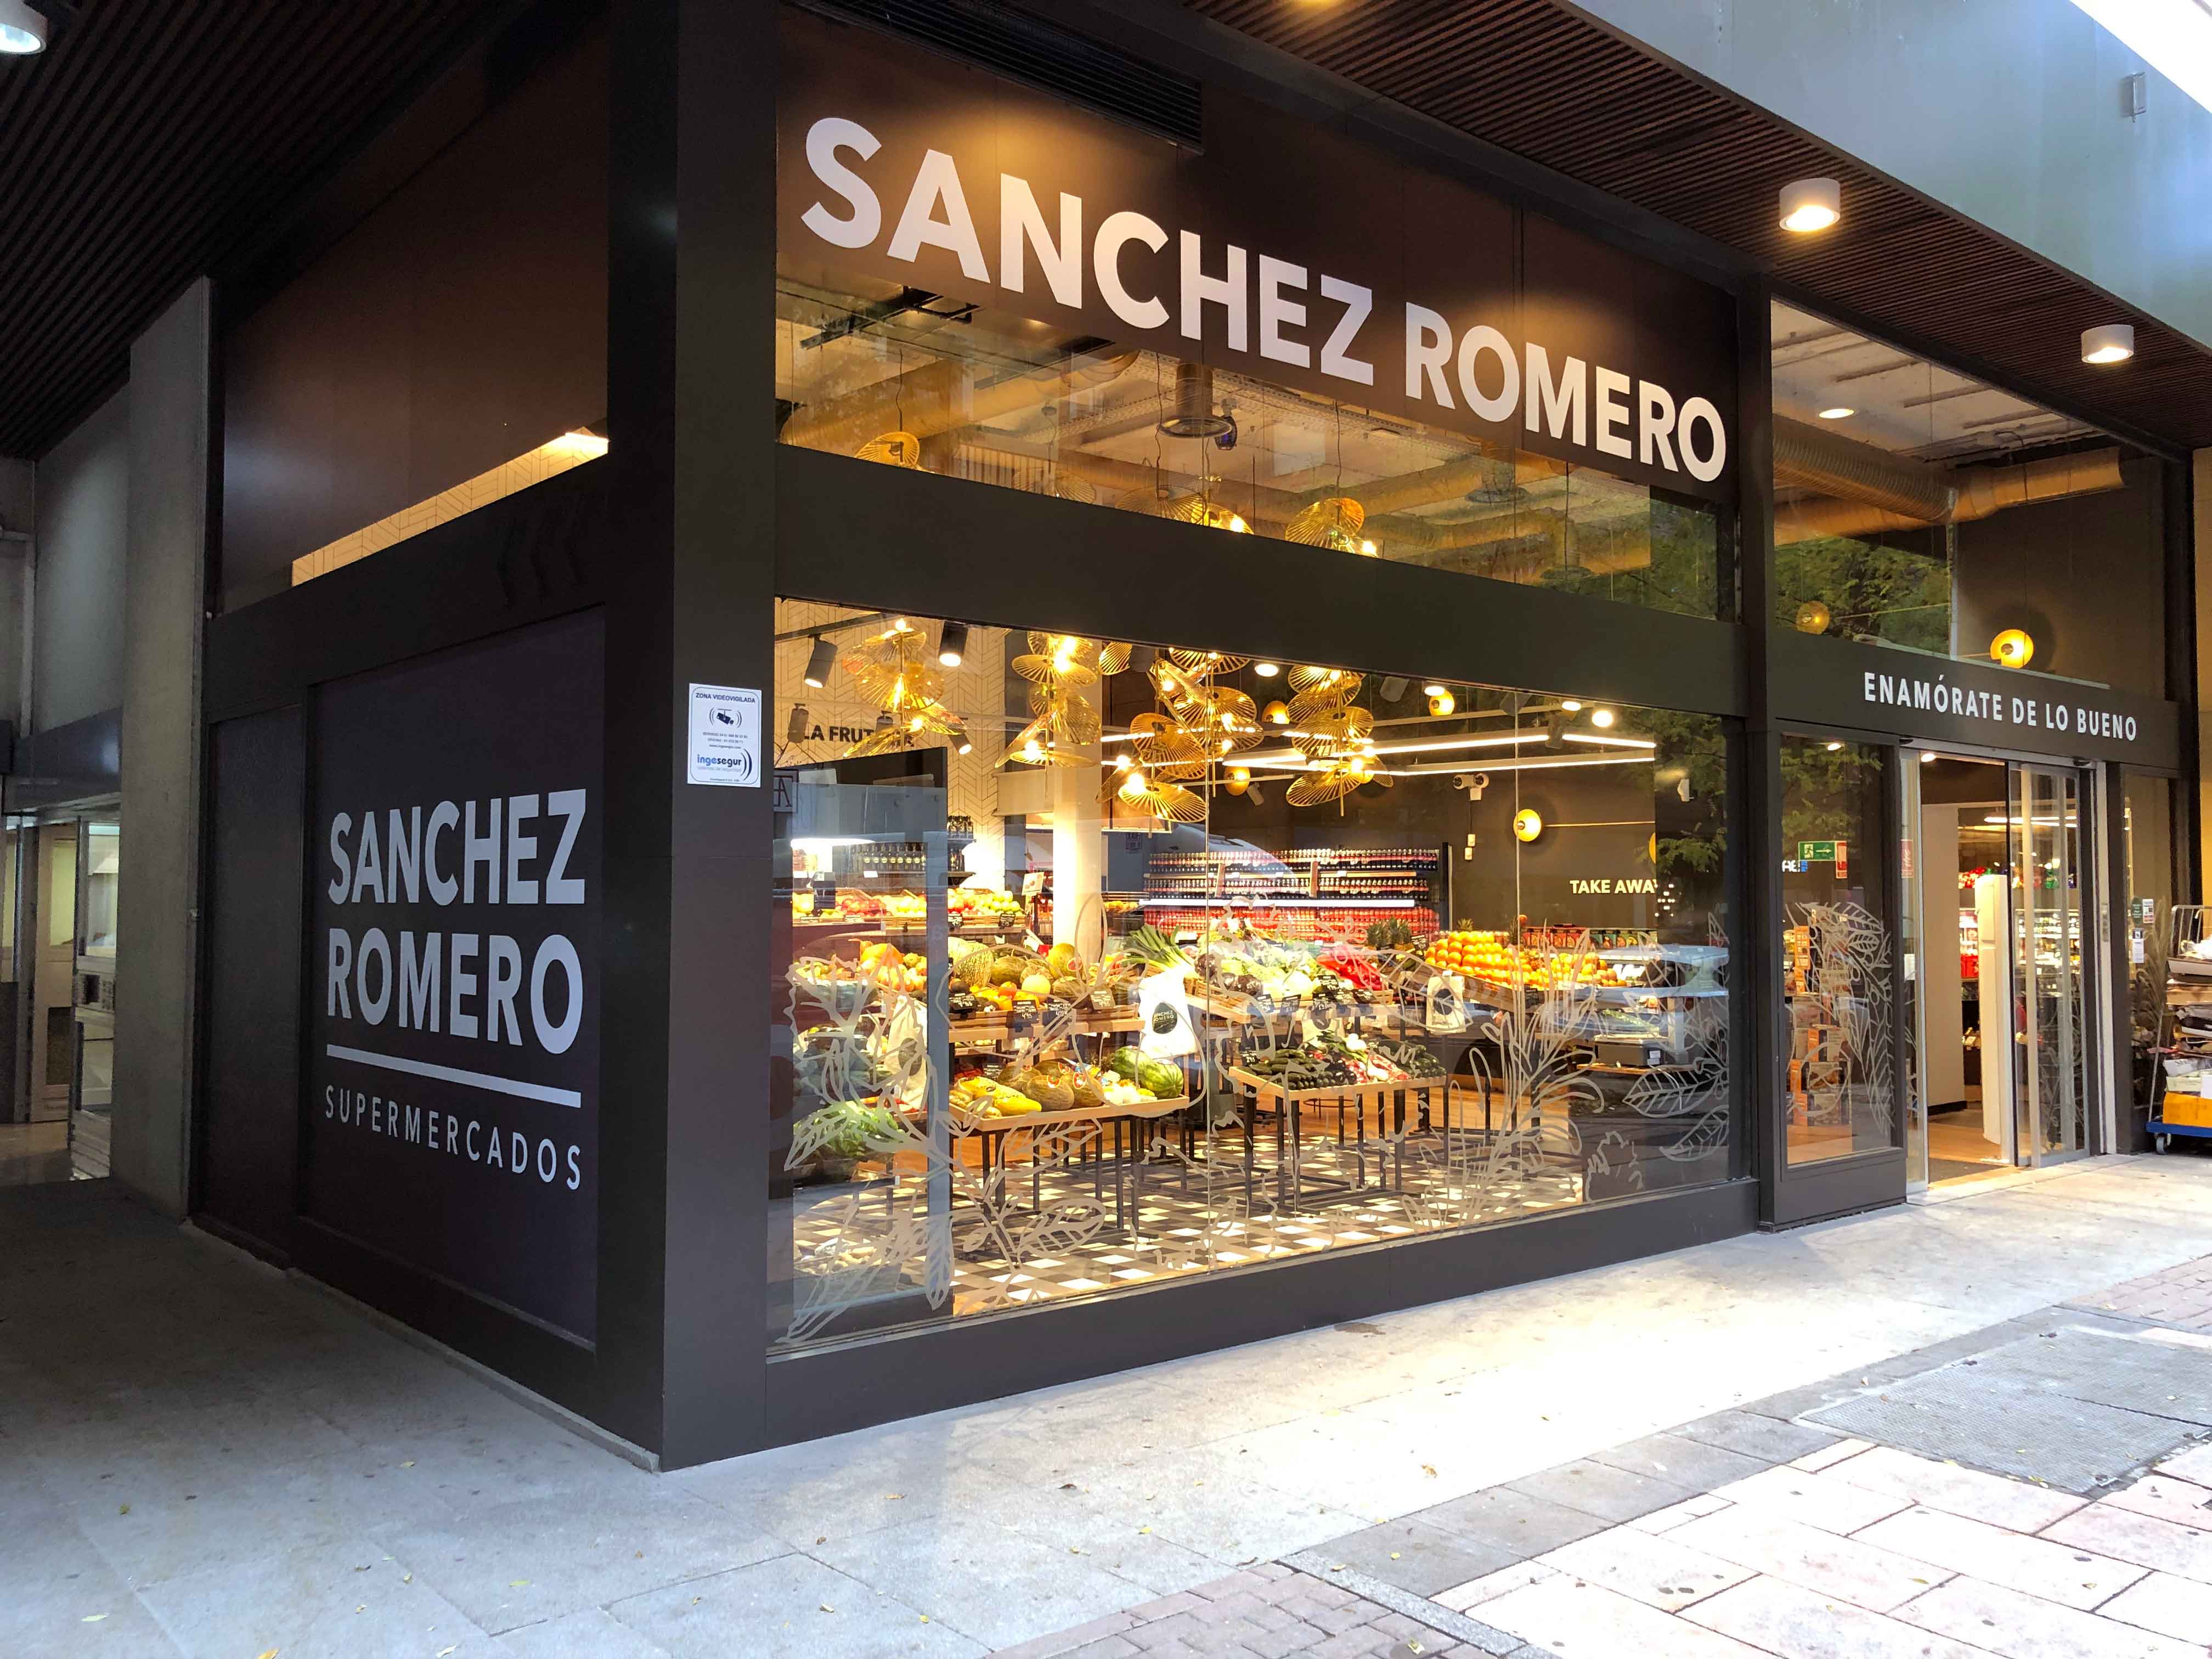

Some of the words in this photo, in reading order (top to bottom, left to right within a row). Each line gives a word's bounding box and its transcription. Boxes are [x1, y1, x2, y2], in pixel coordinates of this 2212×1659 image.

[801, 117, 1373, 386] SANCHEZ
[1406, 304, 1726, 482] ROMERO
[713, 694, 755, 703] VIDEOVIGILADA
[1864, 672, 2002, 721] ENAMÓRATE
[2012, 697, 2037, 726] DE
[2046, 703, 2068, 731] LO
[2077, 708, 2137, 741] BUENO
[697, 754, 742, 768] ingesegur
[328, 788, 586, 906] SANCHEZ
[1570, 879, 1611, 894] TAKE
[327, 927, 584, 1054] ROMERO
[325, 1084, 582, 1191] SUPERMERCADOS
